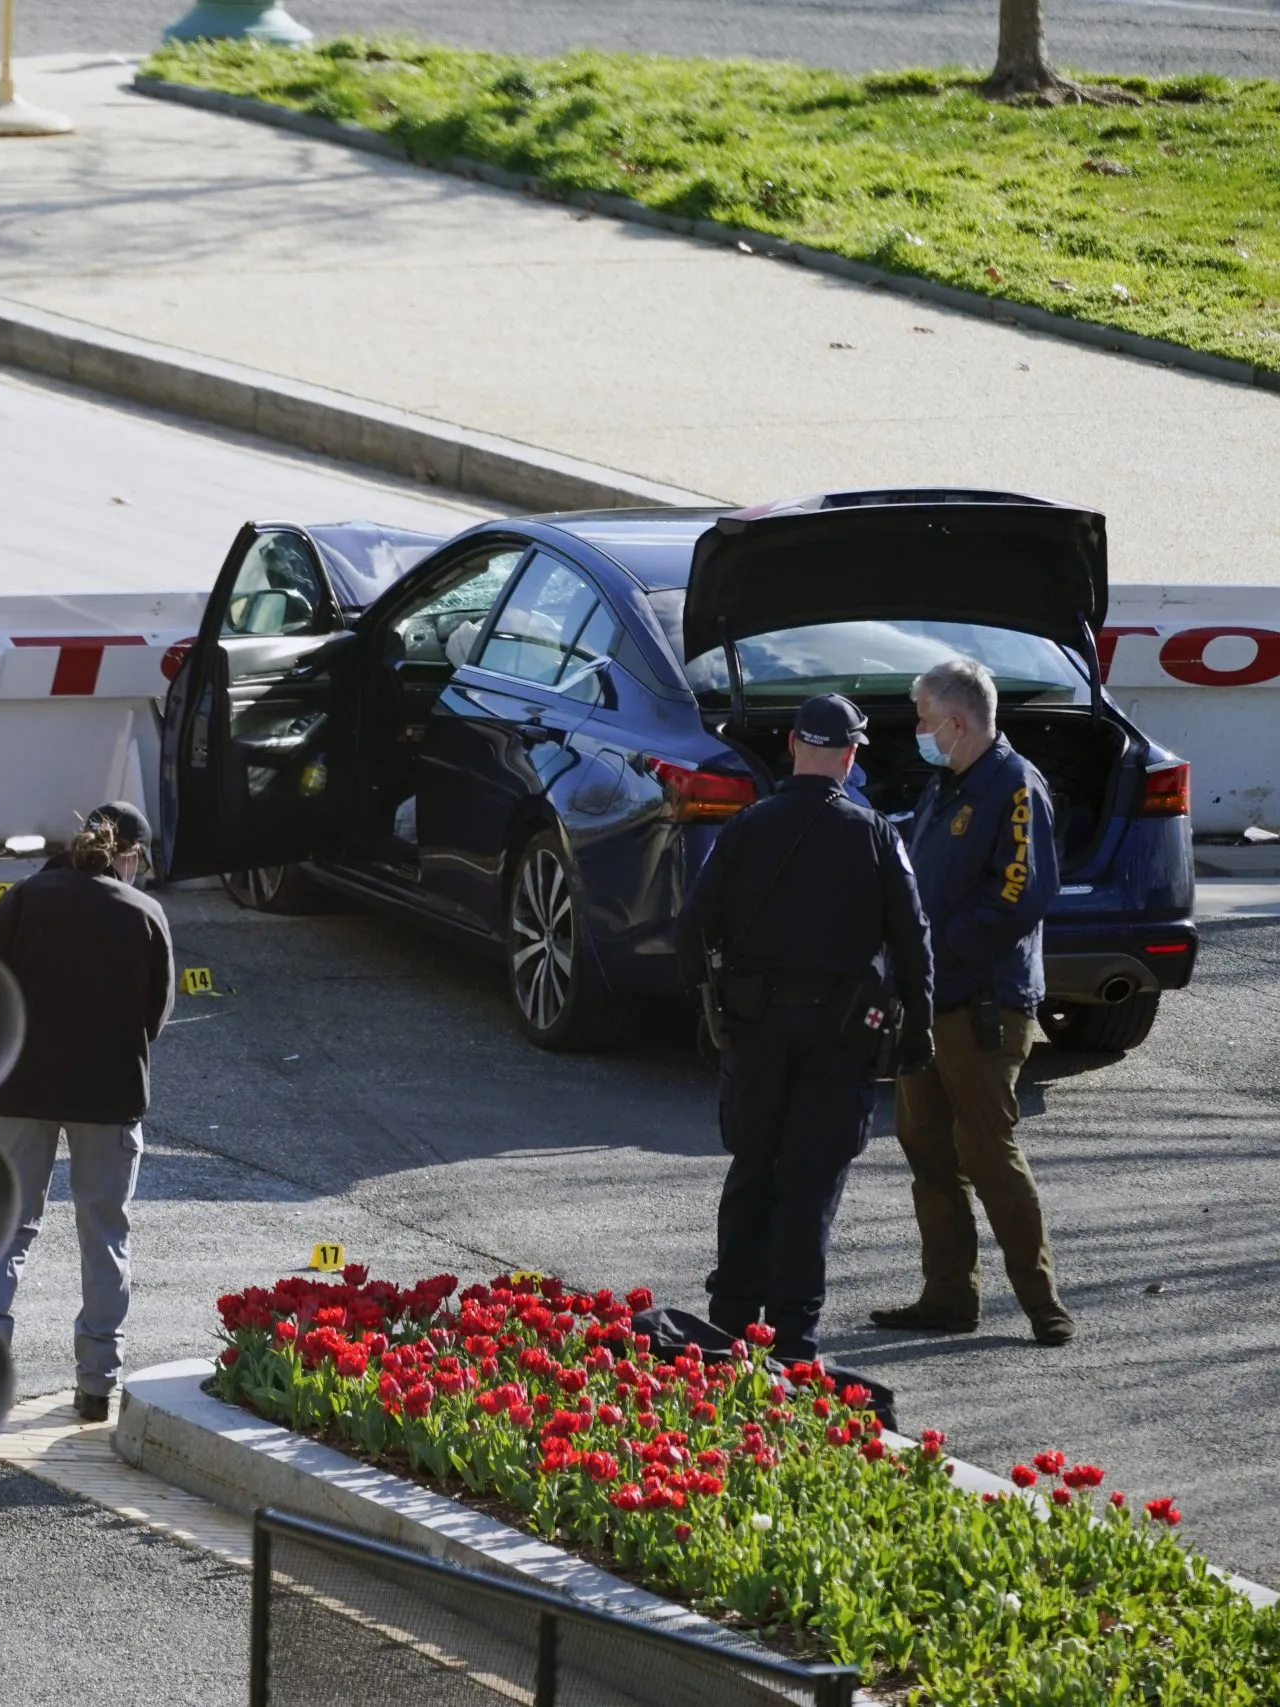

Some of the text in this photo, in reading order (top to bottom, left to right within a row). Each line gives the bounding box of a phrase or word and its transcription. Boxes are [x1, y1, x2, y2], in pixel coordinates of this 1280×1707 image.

[1000, 786, 1031, 904] POLICE
[189, 971, 209, 989] 14
[320, 1246, 339, 1265] 17
